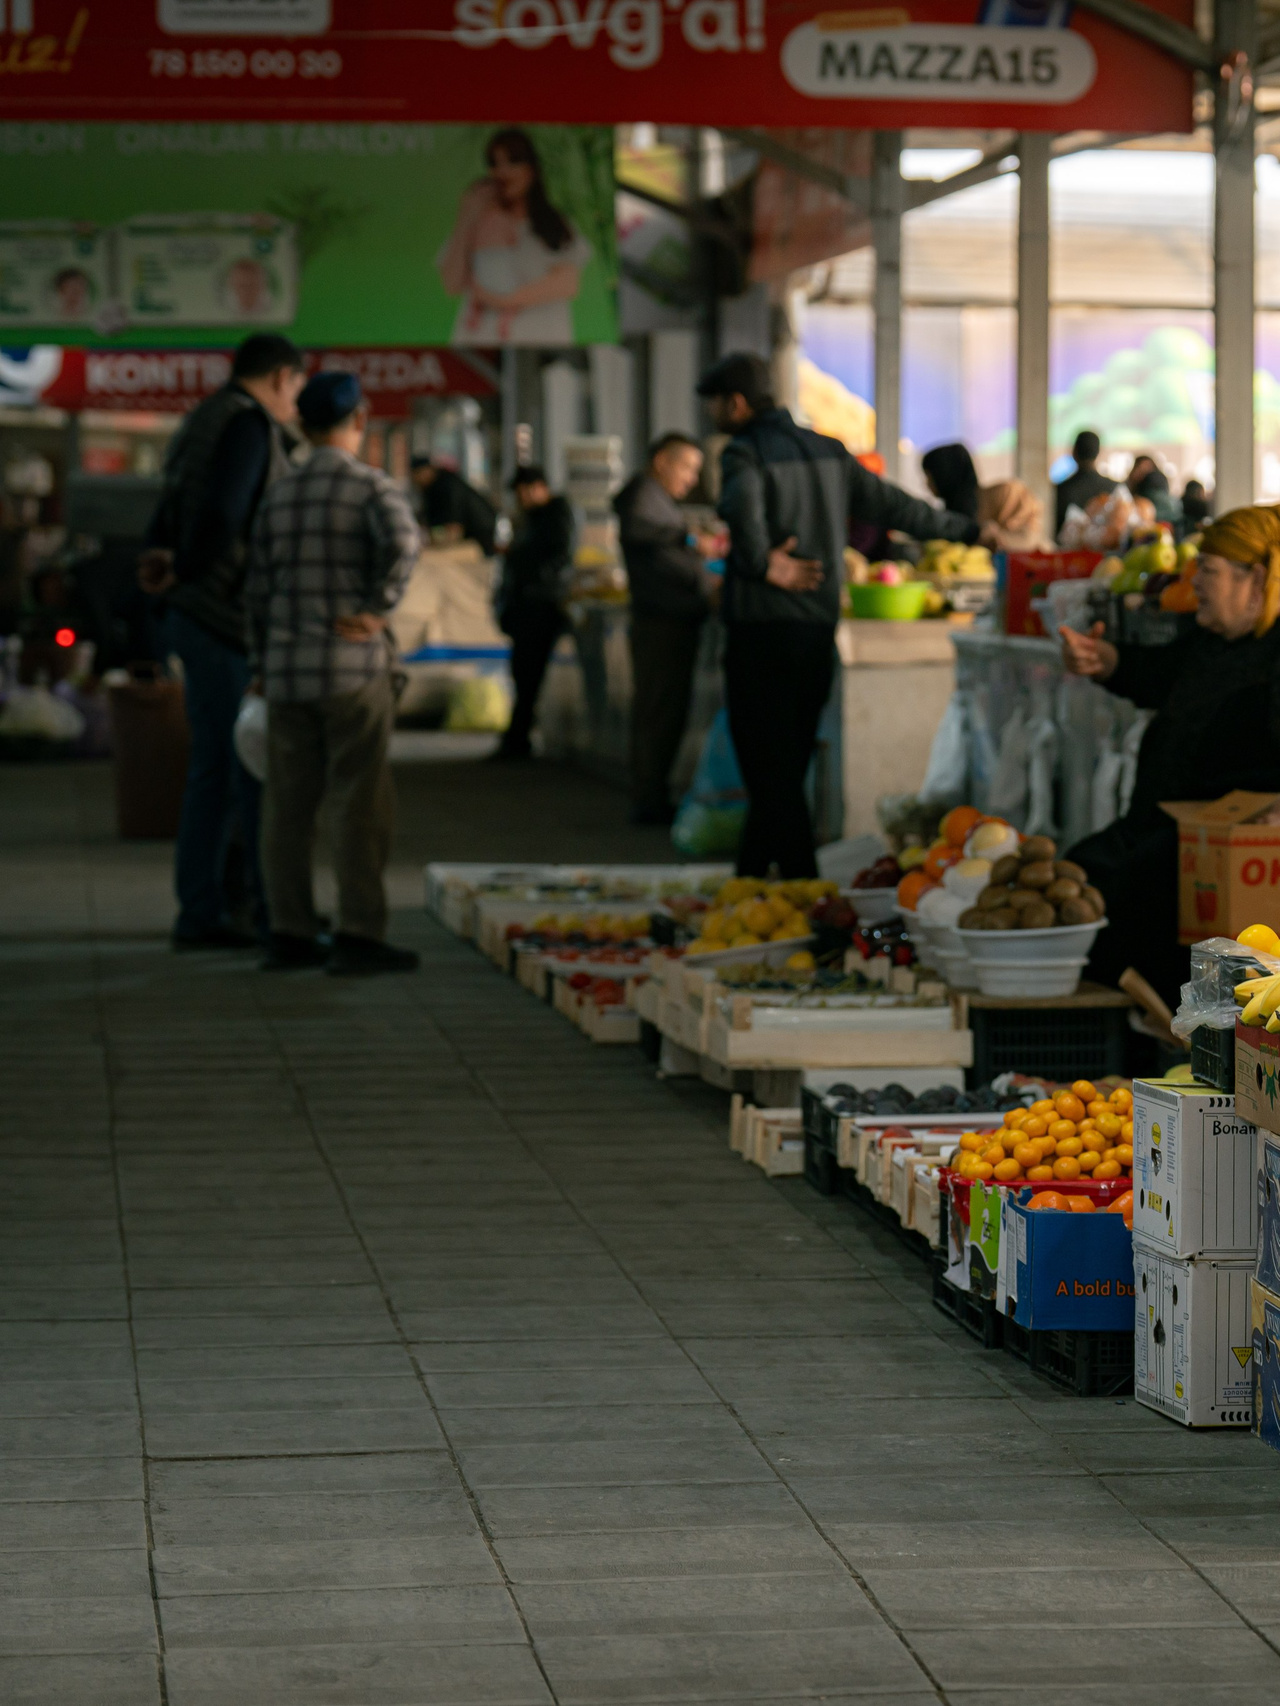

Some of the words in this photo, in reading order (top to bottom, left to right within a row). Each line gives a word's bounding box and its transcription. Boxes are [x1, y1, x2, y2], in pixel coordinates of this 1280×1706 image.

[818, 40, 1059, 86] MAZZA15
[1056, 1280, 1069, 1296] A
[1074, 1279, 1111, 1296] bold
